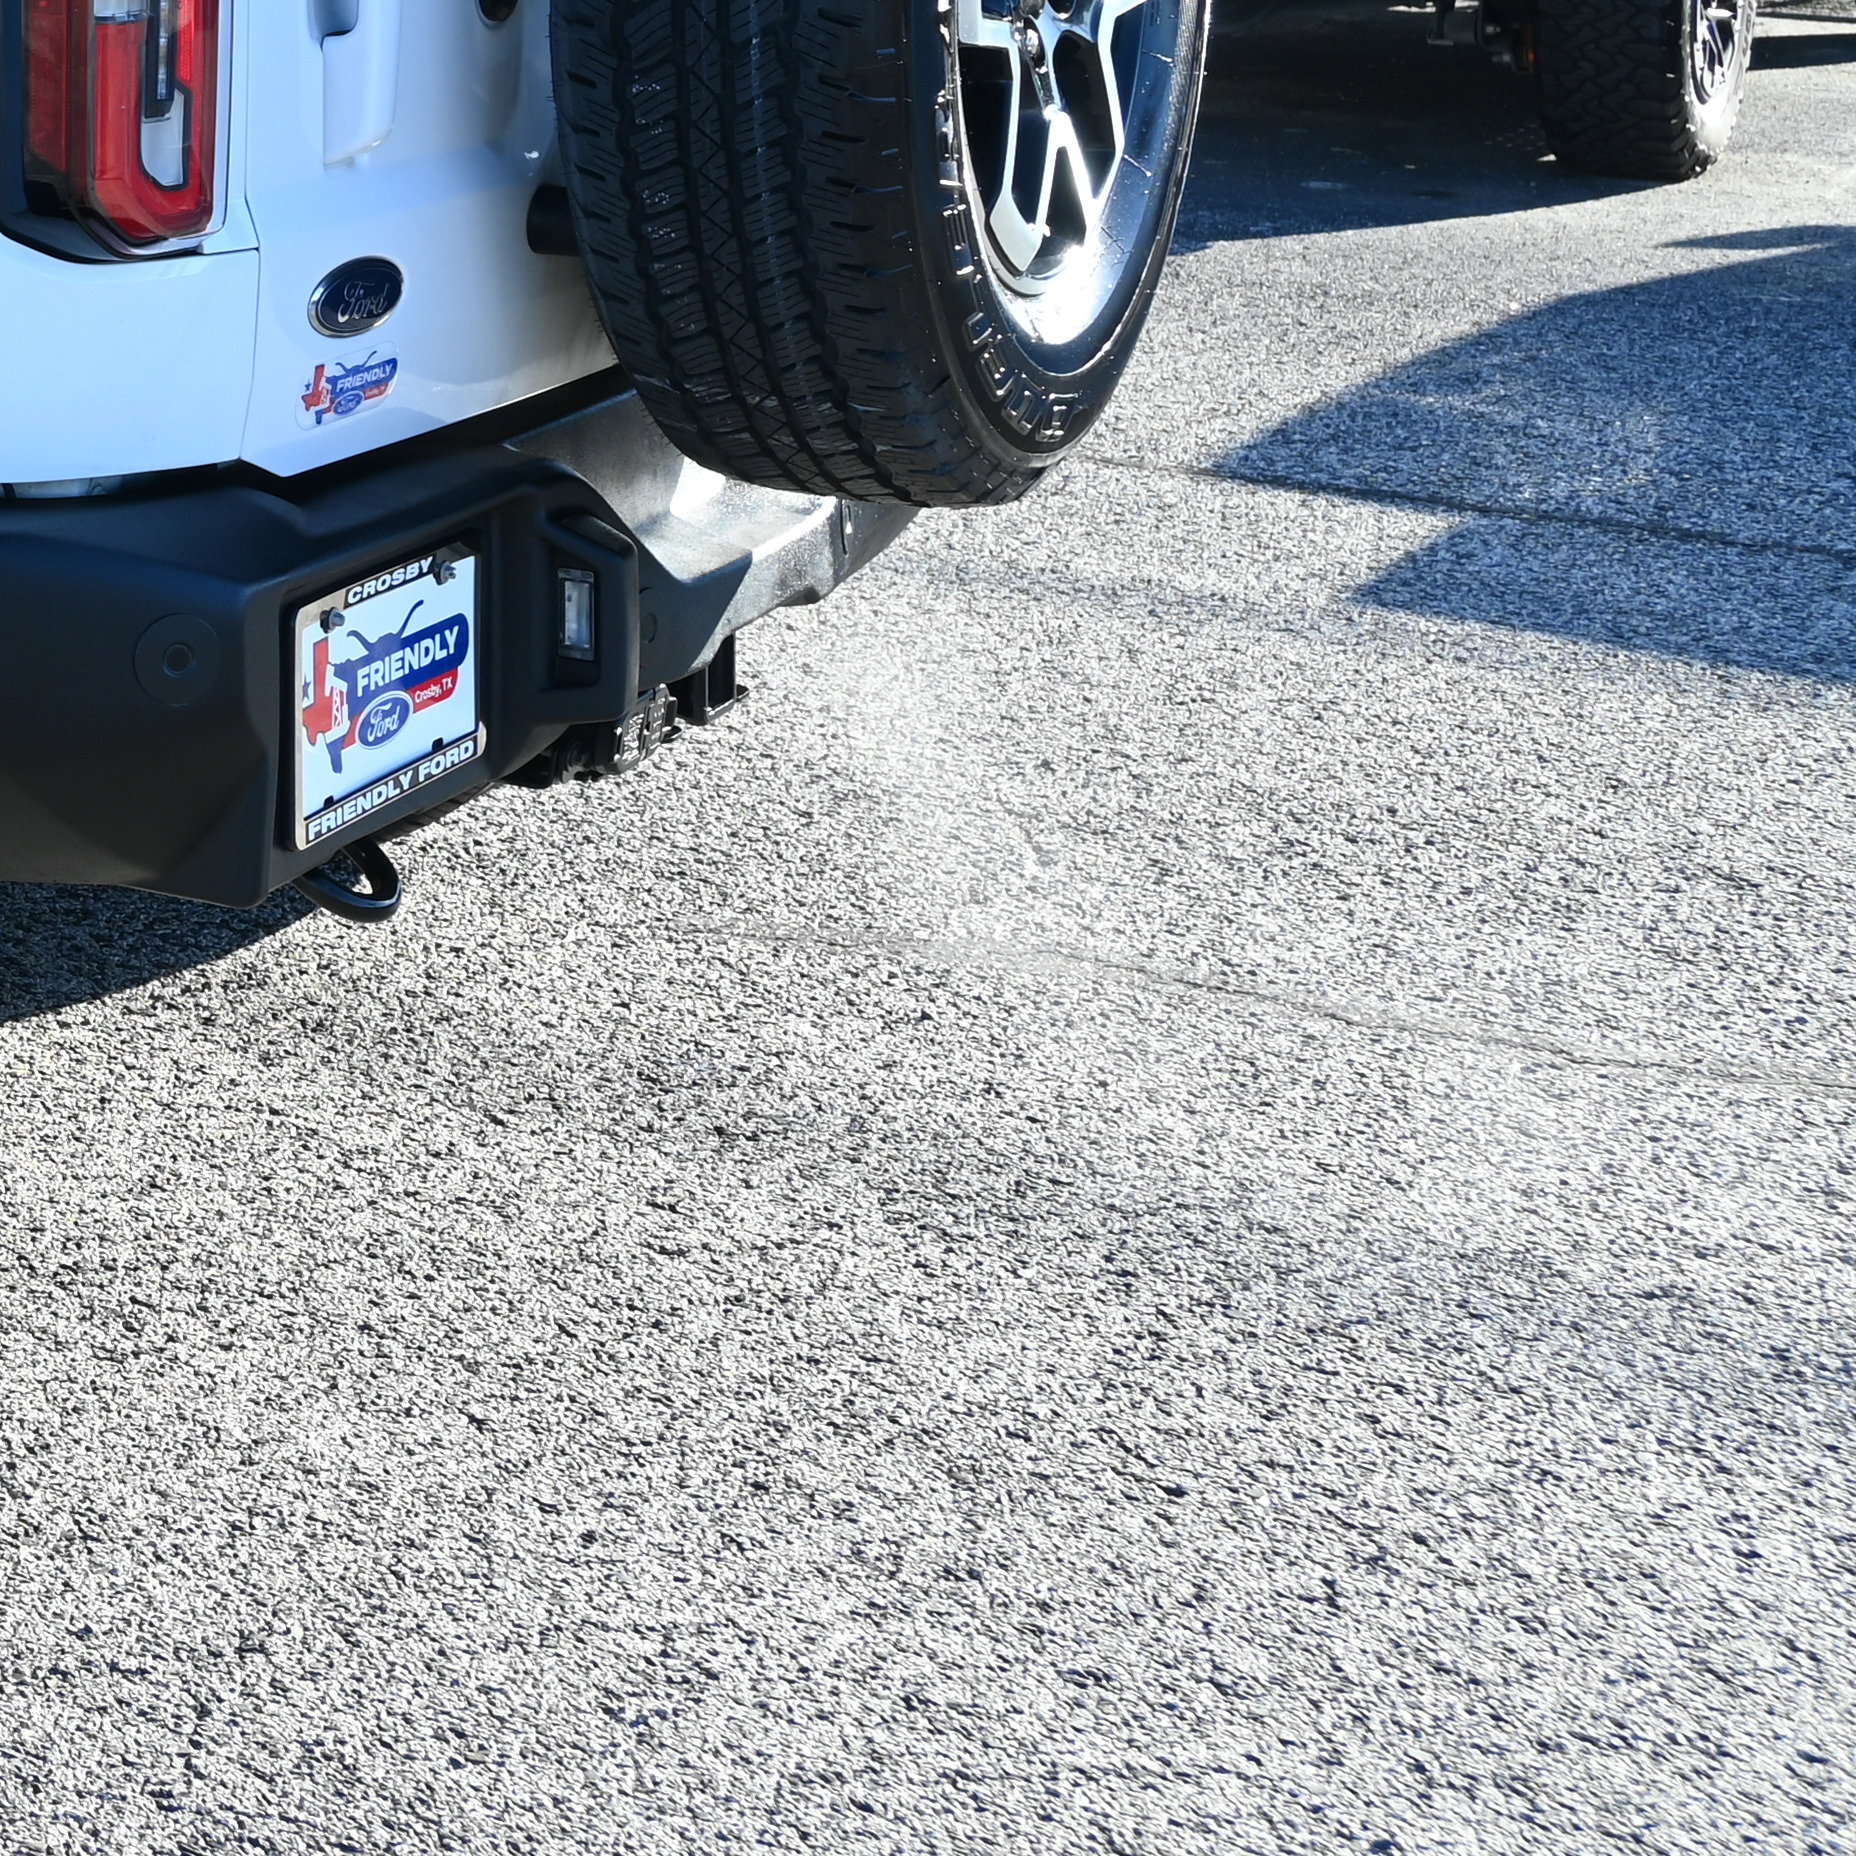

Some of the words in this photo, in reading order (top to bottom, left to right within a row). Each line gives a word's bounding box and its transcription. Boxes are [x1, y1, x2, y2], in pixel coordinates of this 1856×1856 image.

[338, 281, 389, 323] Ford
[336, 363, 394, 393] FRIENDLY
[346, 555, 434, 604] CROSBY
[357, 625, 459, 697] FRIENDLY
[442, 676, 453, 691] TX
[367, 702, 400, 742] Ford
[308, 770, 414, 841] FRIENDLY
[418, 740, 475, 783] FORD
